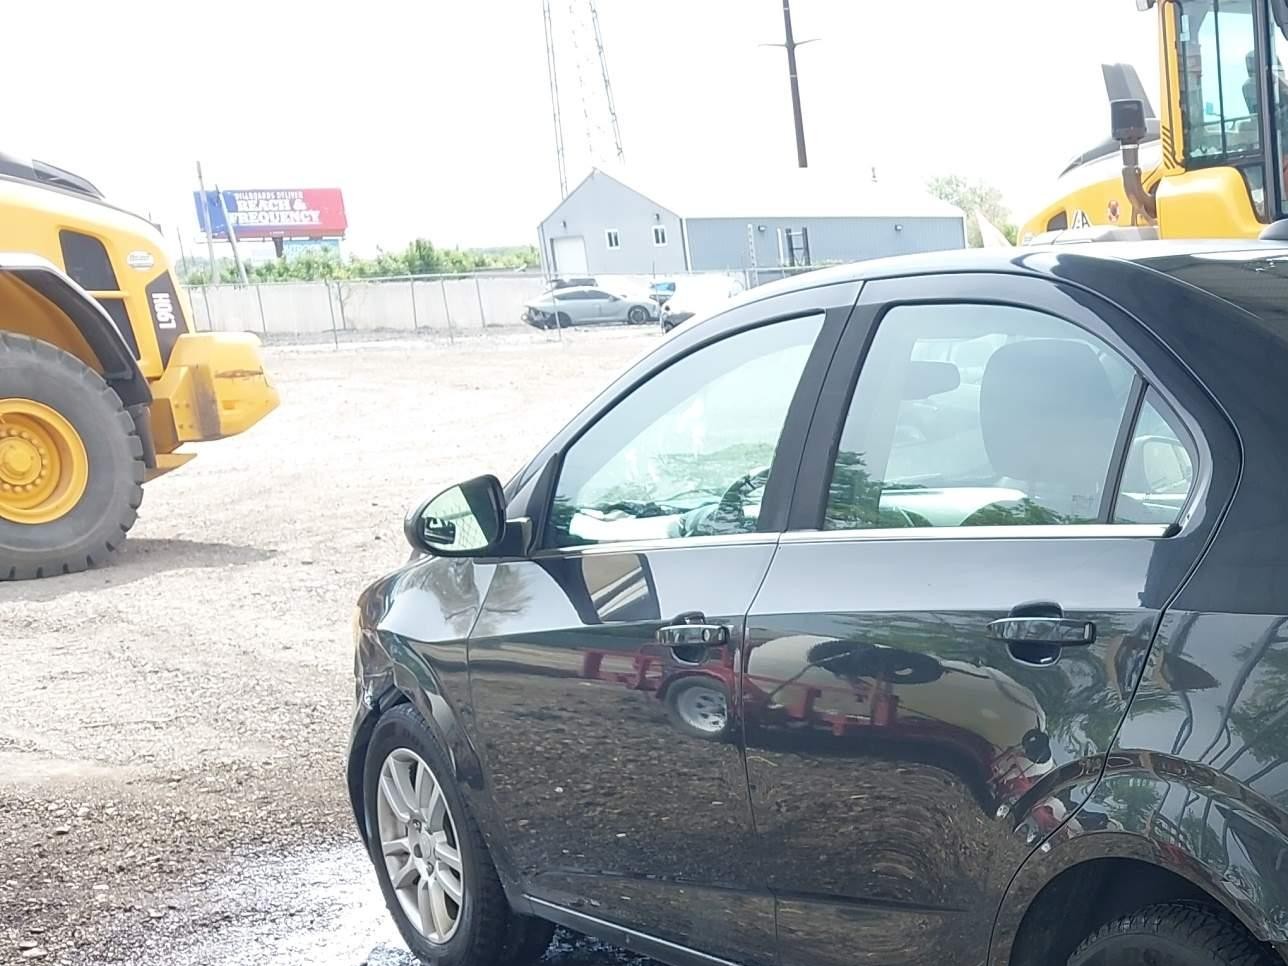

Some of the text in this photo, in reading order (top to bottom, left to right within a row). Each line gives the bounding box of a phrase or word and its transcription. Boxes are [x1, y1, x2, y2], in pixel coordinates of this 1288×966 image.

[238, 199, 290, 212] REACH
[229, 211, 321, 225] FREQUENCY
[151, 292, 177, 329] L90H
